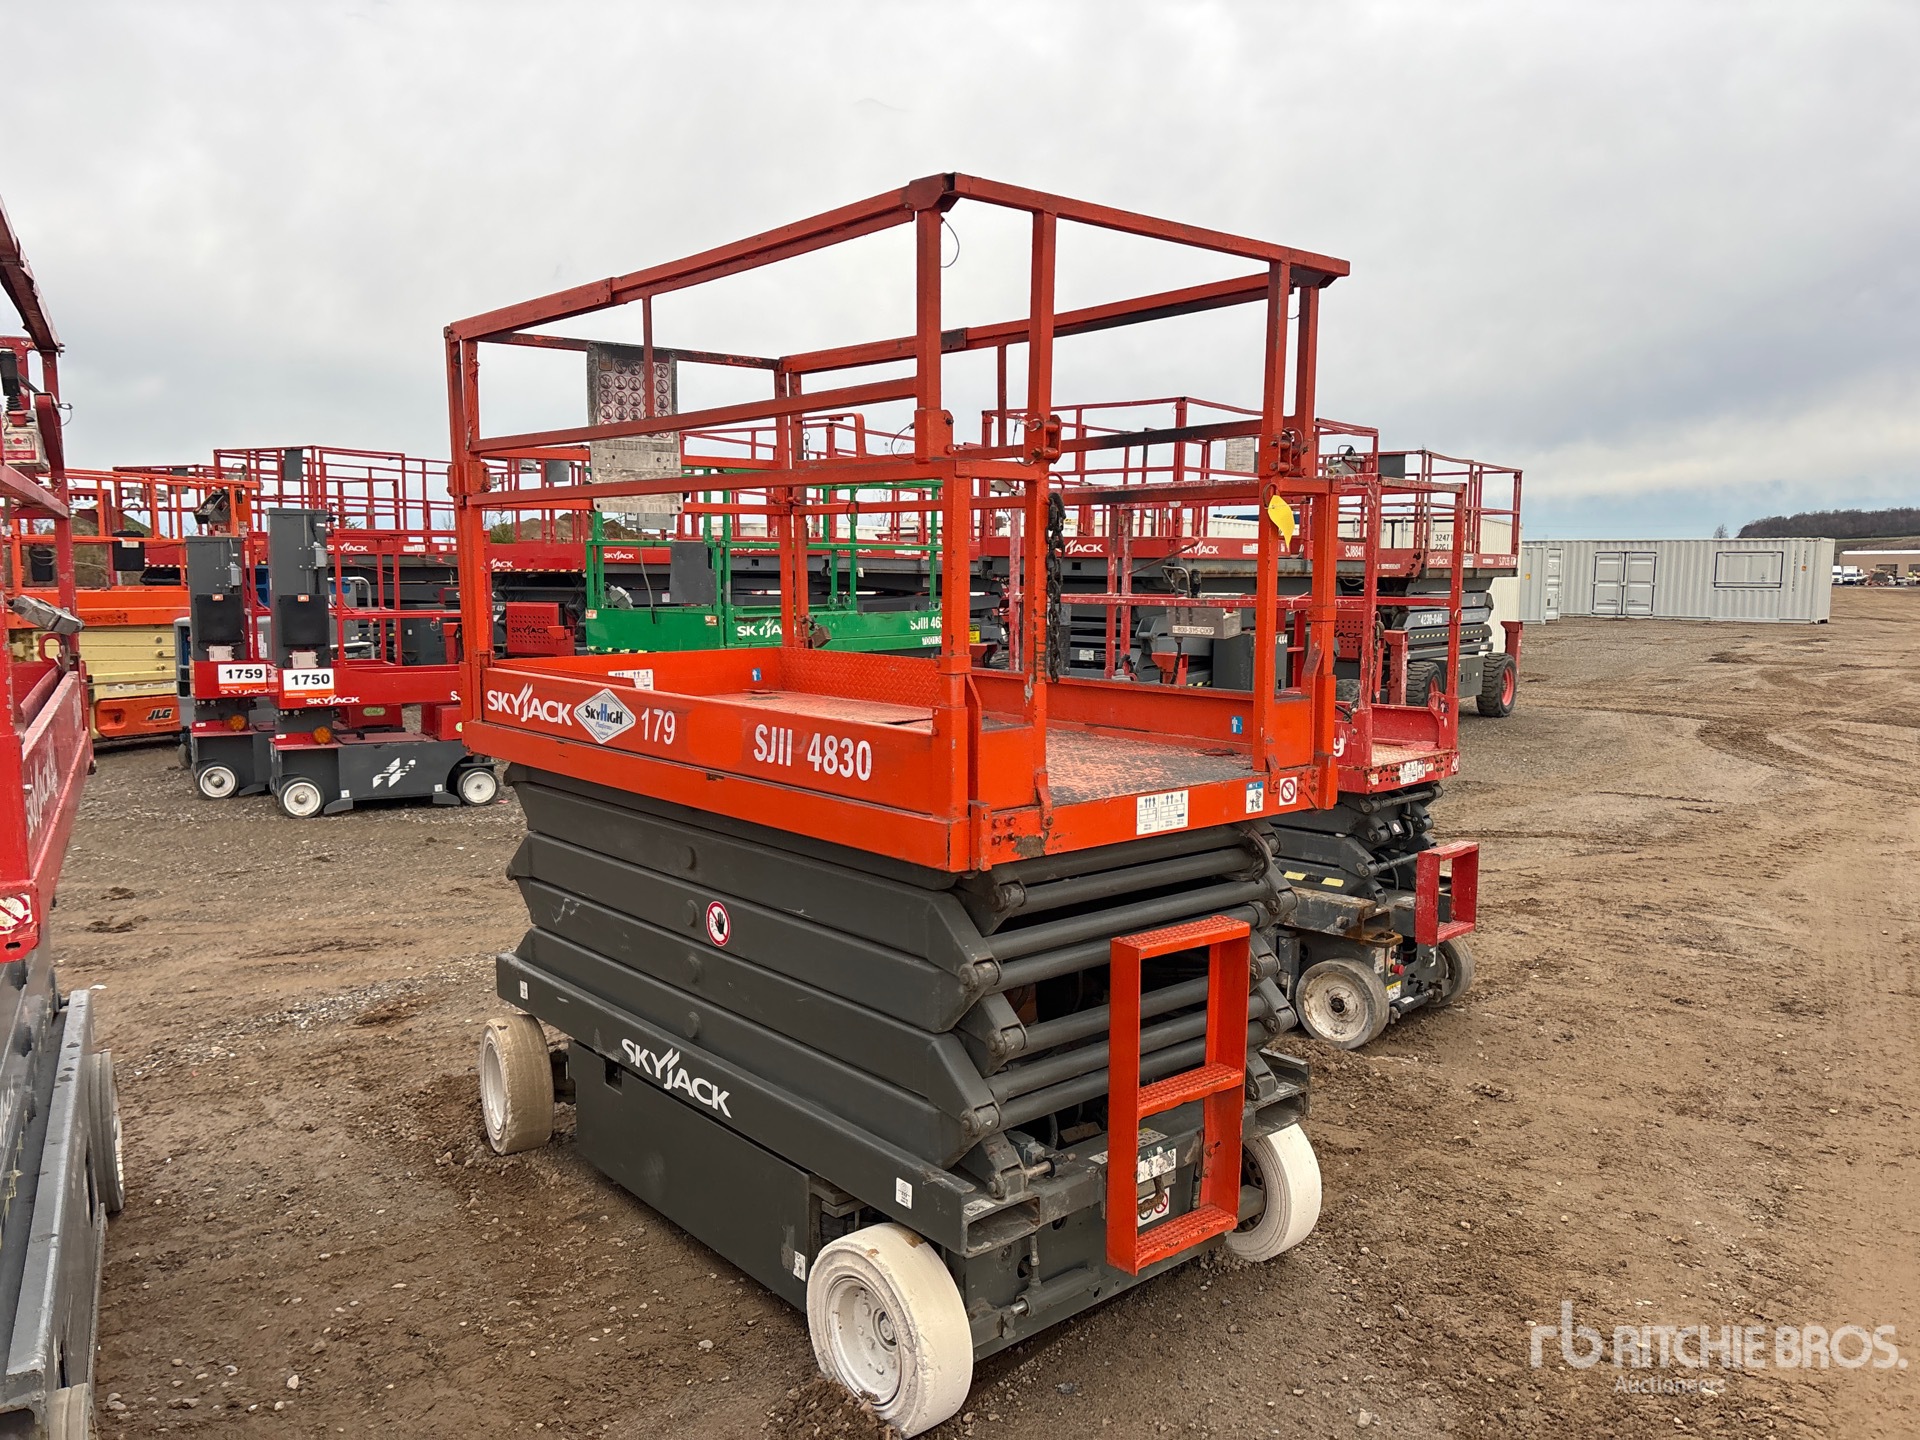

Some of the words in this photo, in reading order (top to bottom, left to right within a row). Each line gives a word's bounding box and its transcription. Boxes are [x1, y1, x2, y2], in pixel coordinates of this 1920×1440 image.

[327, 542, 368, 552] SYJACK
[1345, 545, 1364, 557] SJ8841
[604, 551, 635, 560] SKYJACK
[511, 625, 550, 635] SKYJACK
[226, 669, 263, 679] 1759
[291, 674, 330, 685] 1750
[306, 694, 360, 705] SKYJACK
[487, 683, 573, 726] SKYJACK
[147, 709, 172, 720] JLG
[641, 708, 676, 745] 179
[753, 724, 793, 767] SJII
[807, 733, 872, 781] 4830
[621, 1038, 732, 1119] SKYJACK
